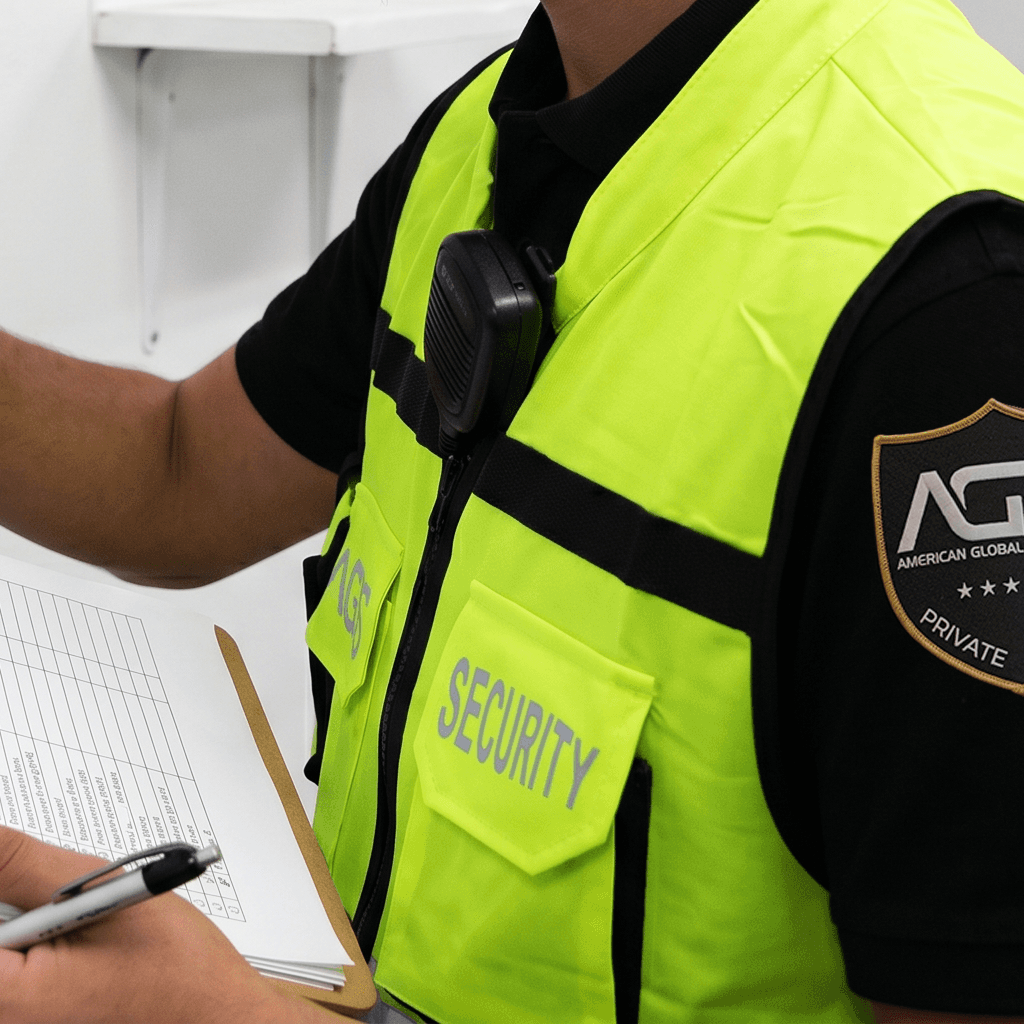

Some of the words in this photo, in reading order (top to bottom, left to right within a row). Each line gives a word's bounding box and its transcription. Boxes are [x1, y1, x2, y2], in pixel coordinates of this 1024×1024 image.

[897, 547, 967, 571] AMERICAN
[970, 541, 1024, 559] GLOBAL
[919, 607, 1010, 669] PRIVATE
[437, 656, 601, 811] SECURITY
